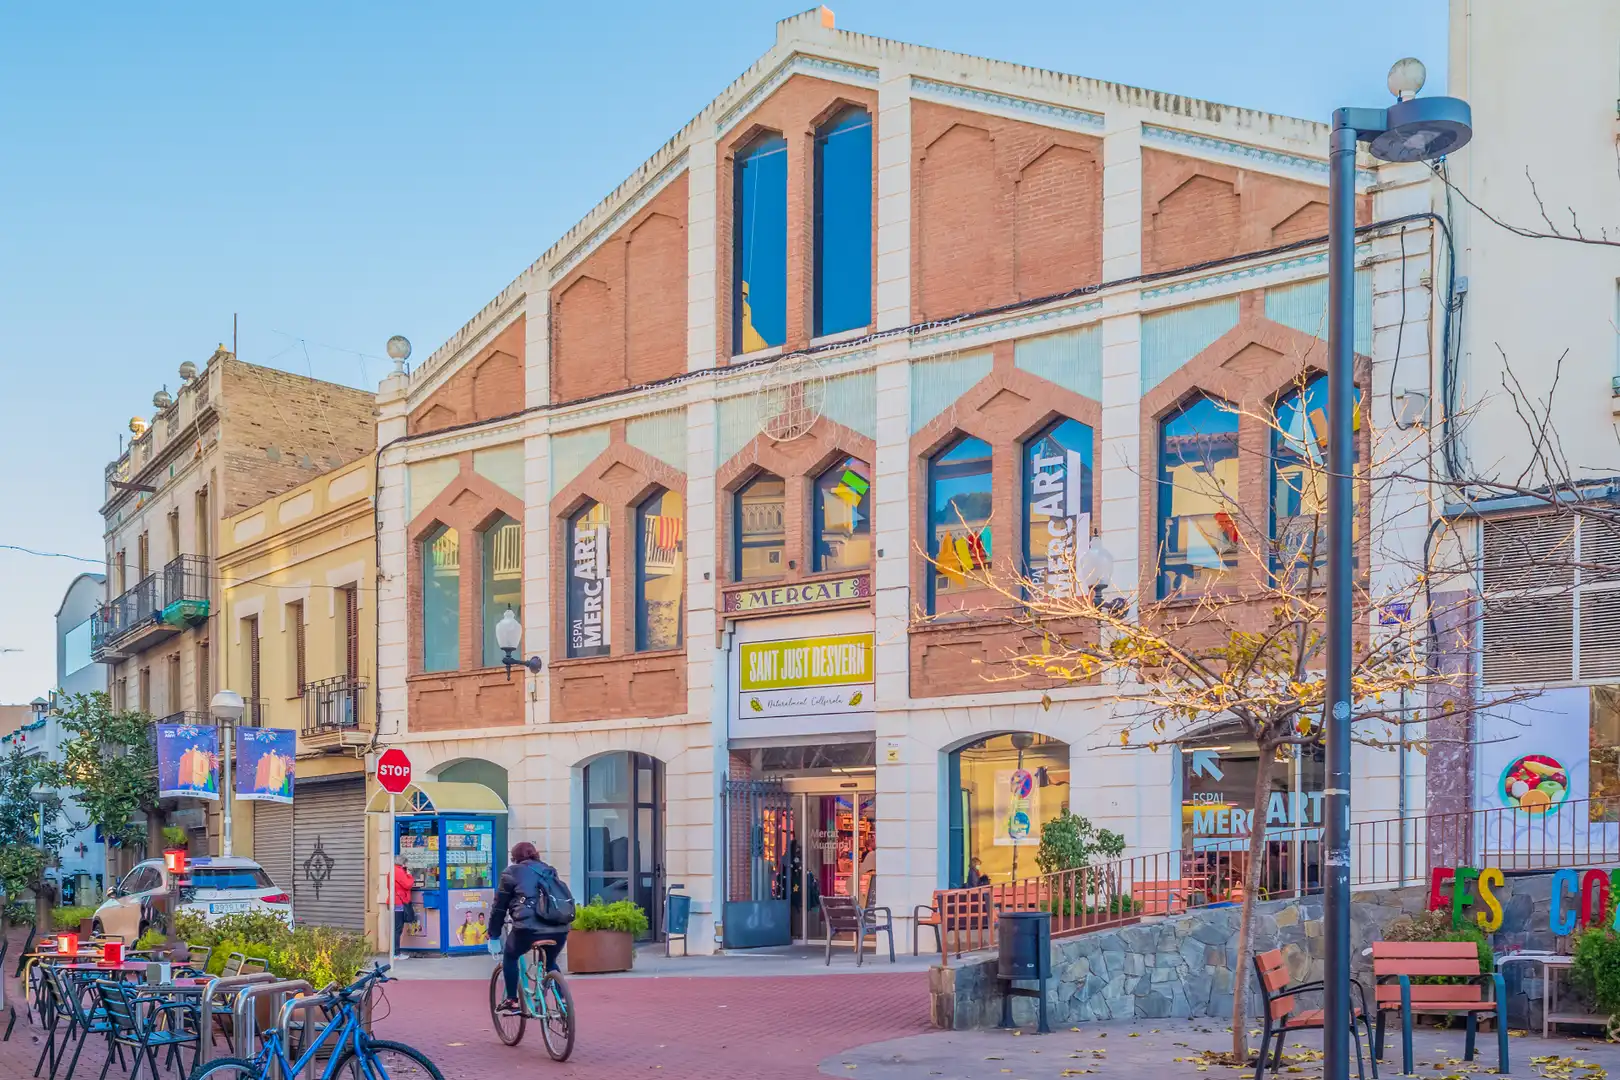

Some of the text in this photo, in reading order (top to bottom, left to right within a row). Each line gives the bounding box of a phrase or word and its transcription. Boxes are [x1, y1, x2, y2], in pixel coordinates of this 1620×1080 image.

[574, 527, 602, 647] MERCART
[749, 582, 844, 607] MERCAT
[573, 619, 583, 648] ESPAI
[749, 642, 865, 682] SANT JUST DESVERN
[380, 764, 410, 777] STOP
[1193, 792, 1223, 806] ESPAI
[810, 829, 839, 838] Mercat
[810, 839, 851, 850] Municipal
[1550, 868, 1620, 935] CO
